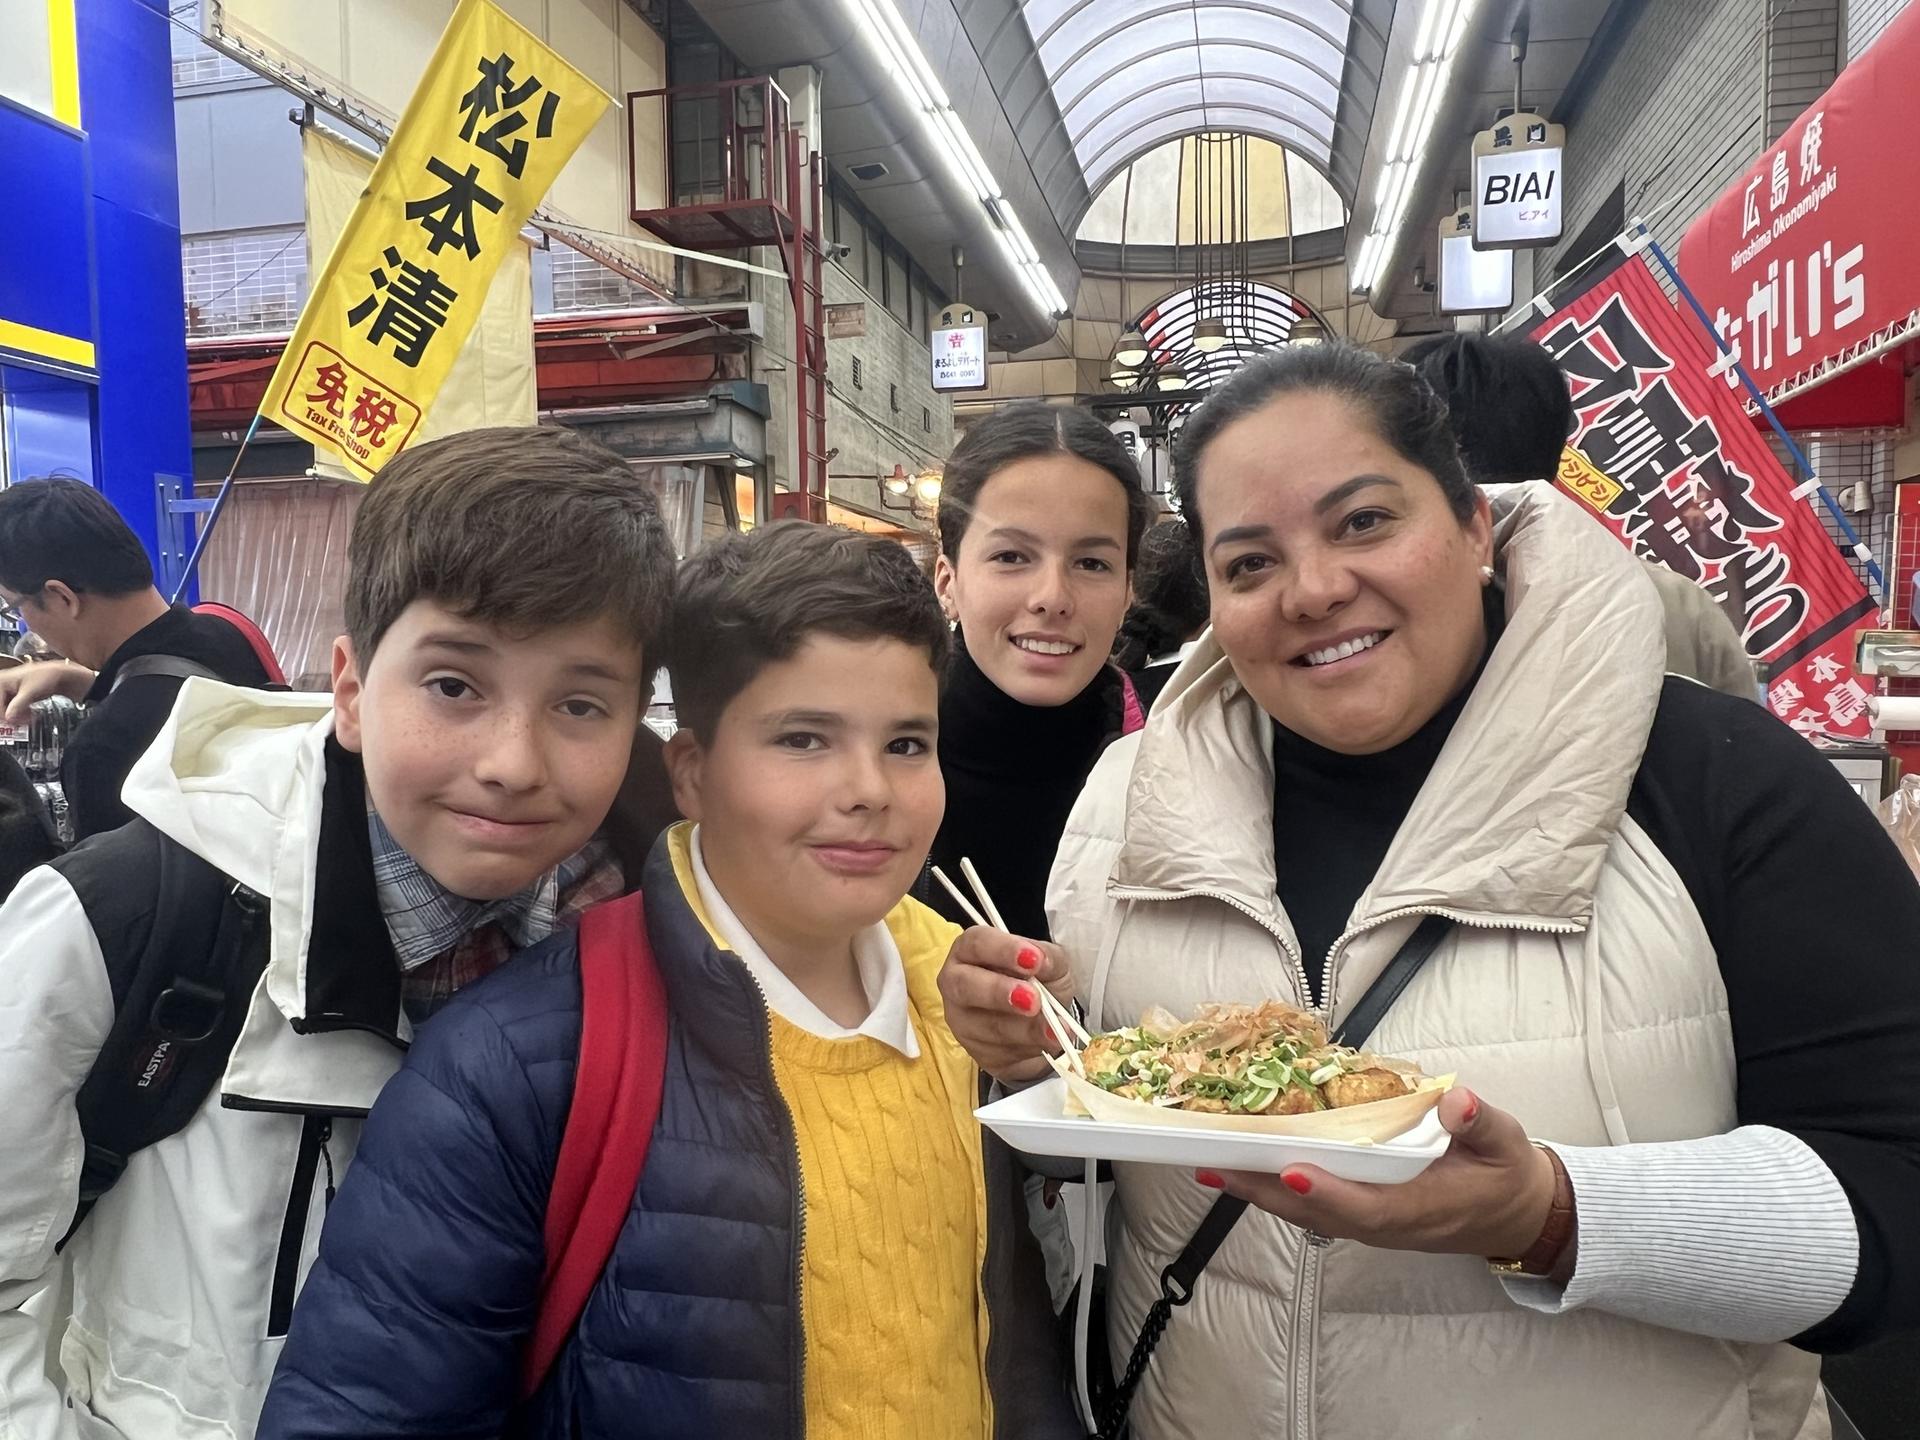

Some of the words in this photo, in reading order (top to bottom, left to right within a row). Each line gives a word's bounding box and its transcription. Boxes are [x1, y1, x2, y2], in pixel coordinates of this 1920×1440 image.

[347, 52, 561, 368] 松本清
[1483, 170, 1555, 206] BIAI
[1731, 229, 1772, 274] Hiroshima
[1773, 166, 1837, 239] Okonomiyaki
[306, 406, 328, 428] Tax
[137, 1040, 170, 1087] EASTPA
